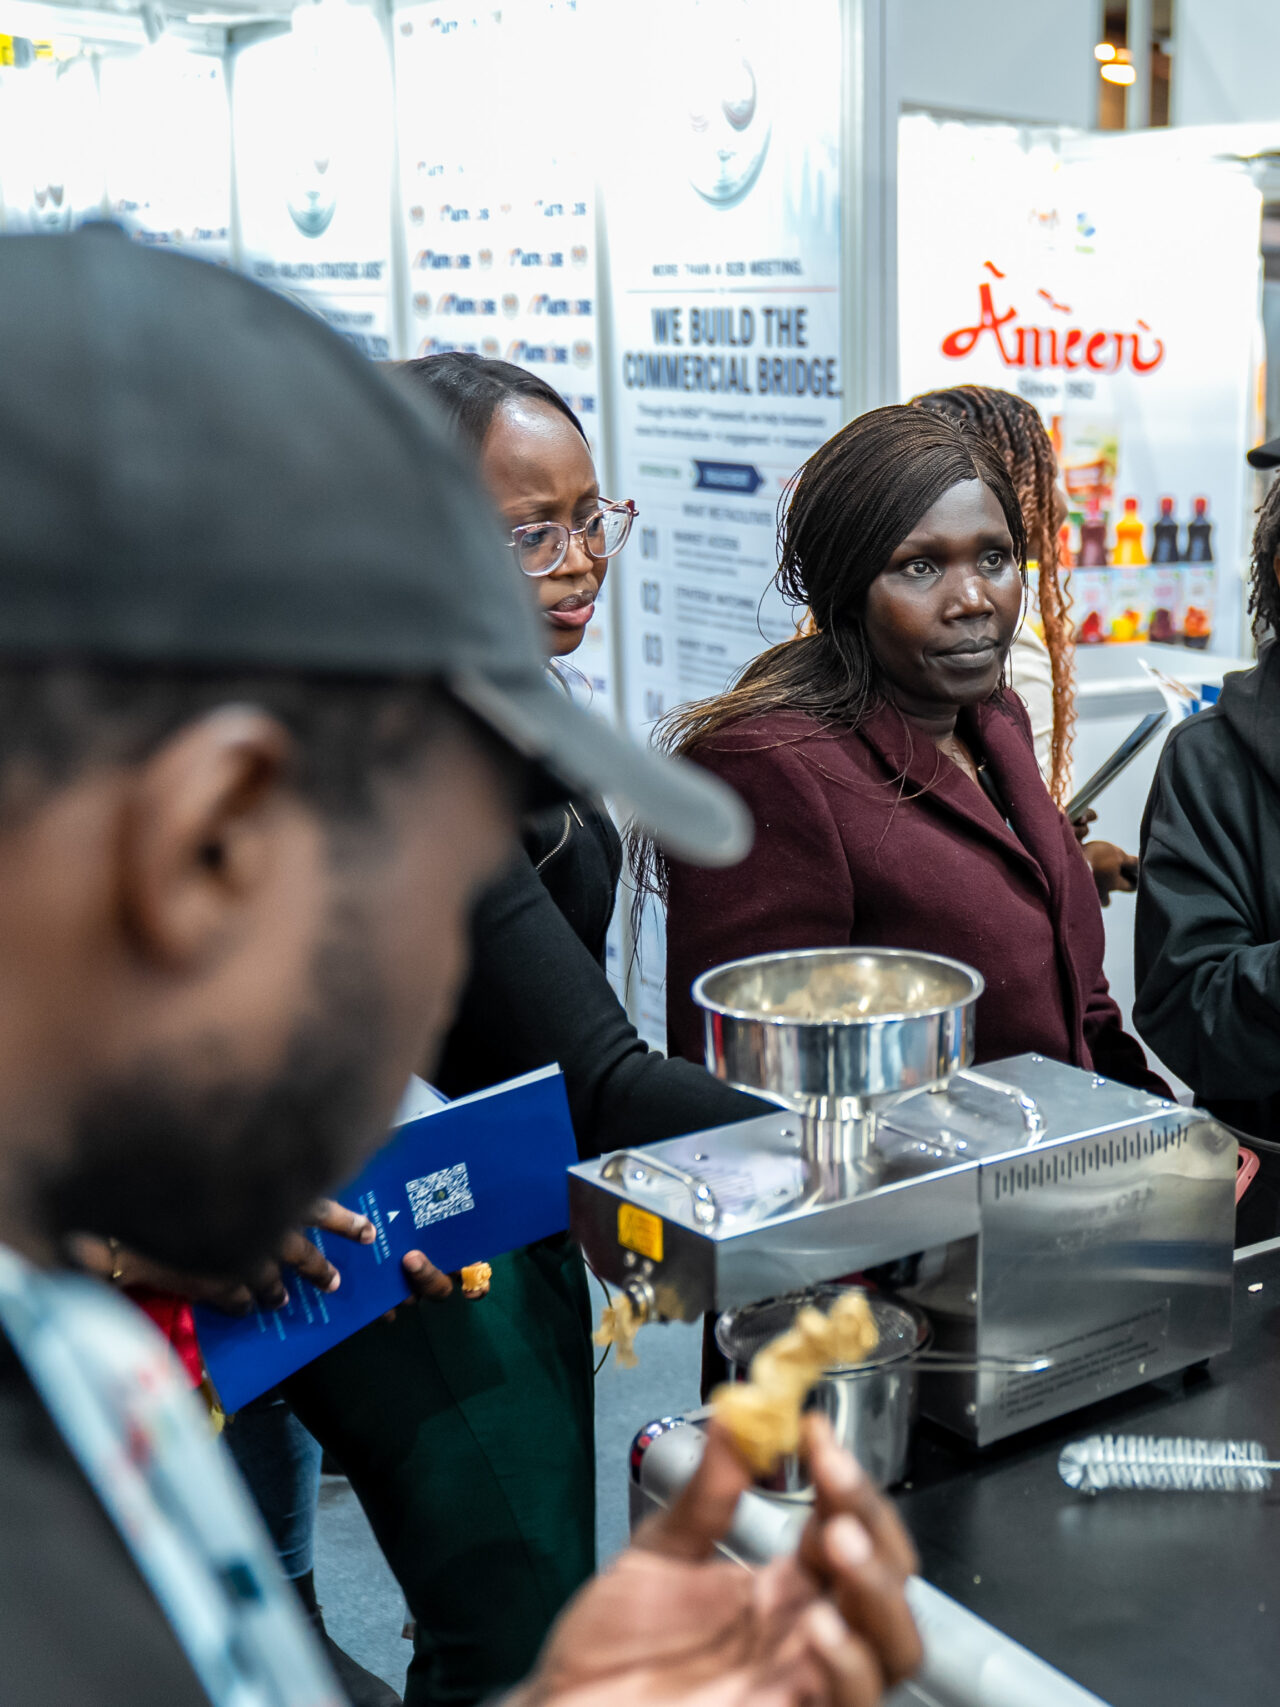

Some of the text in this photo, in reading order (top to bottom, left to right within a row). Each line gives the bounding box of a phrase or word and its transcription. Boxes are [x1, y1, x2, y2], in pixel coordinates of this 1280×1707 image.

[652, 306, 808, 348] WE BUILD THE
[623, 352, 843, 398] COMMERCIAL BRIDGE.
